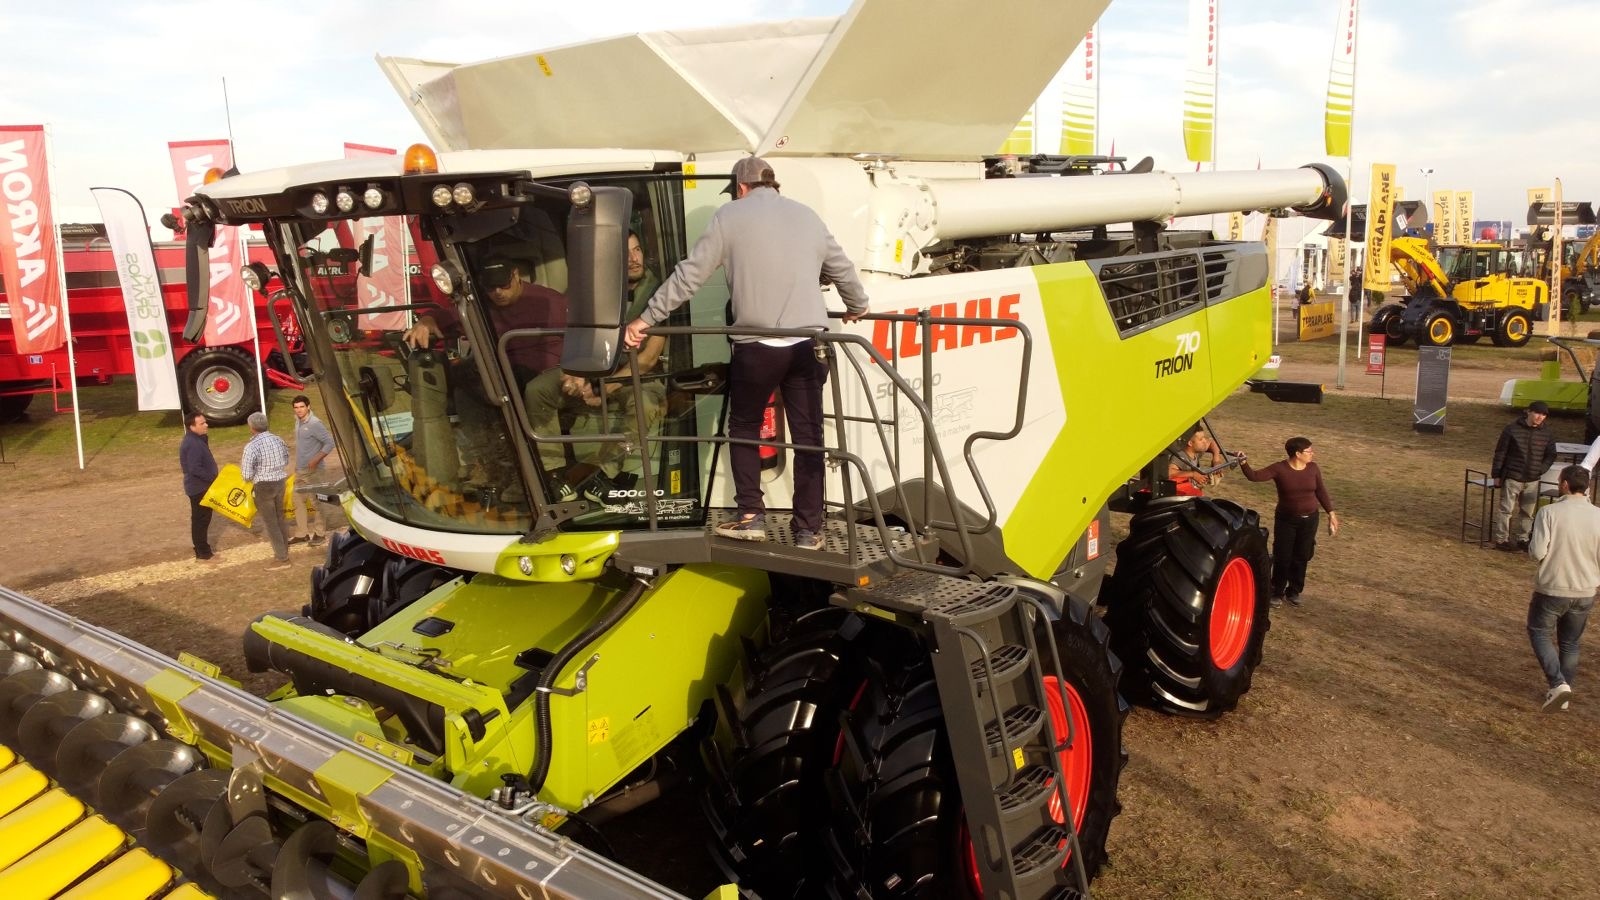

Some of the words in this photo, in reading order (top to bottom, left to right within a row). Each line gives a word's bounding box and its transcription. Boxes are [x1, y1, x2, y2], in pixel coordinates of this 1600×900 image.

[226, 197, 267, 214] TRION
[869, 293, 1020, 364] CLAAS
[1175, 331, 1200, 357] 710
[1155, 352, 1193, 379] TRION
[381, 537, 446, 565] CLAAS
